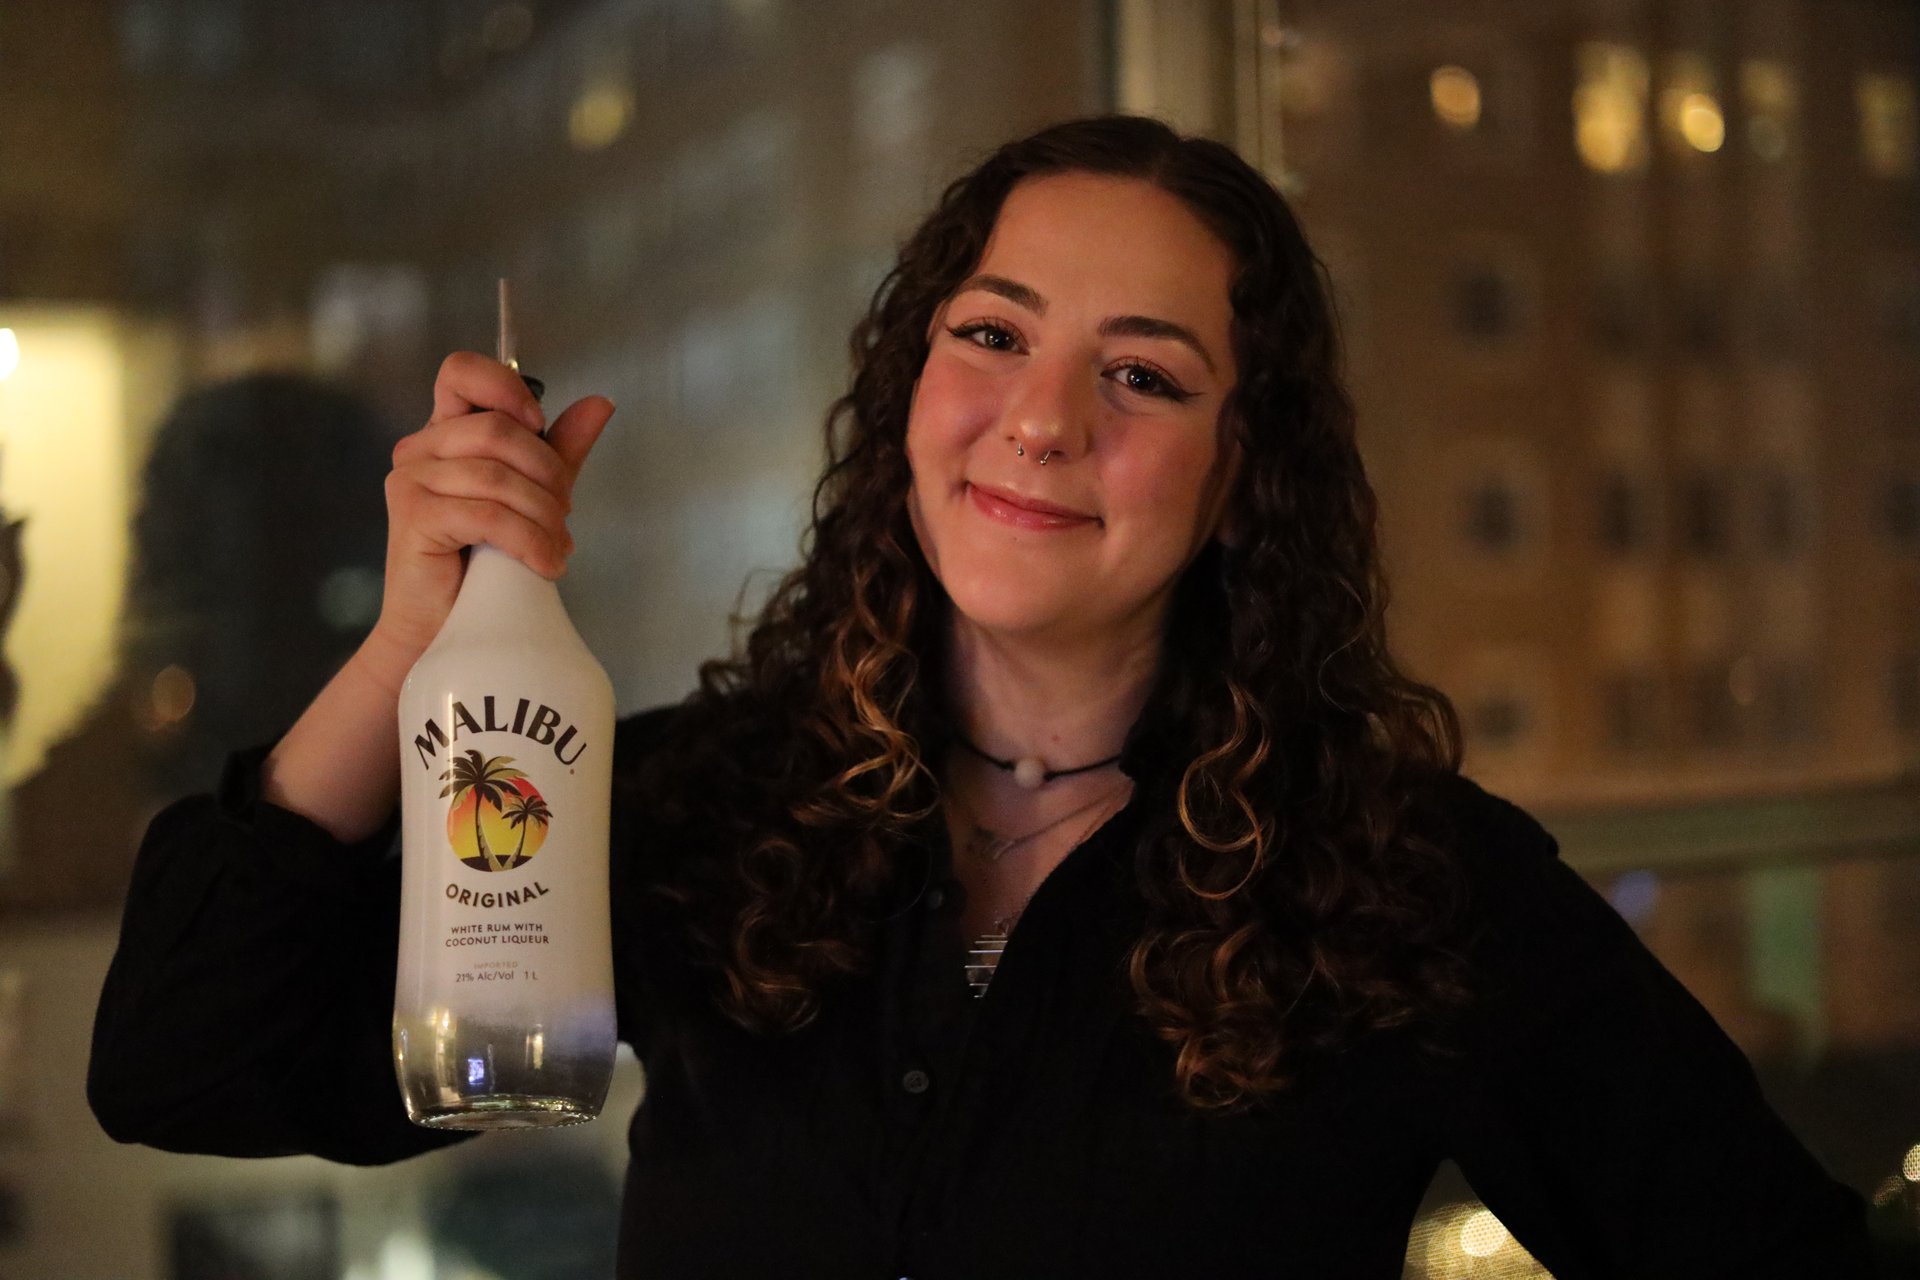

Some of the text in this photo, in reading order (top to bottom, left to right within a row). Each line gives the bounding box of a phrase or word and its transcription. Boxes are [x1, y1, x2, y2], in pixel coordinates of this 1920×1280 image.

[414, 696, 587, 771] MALIBU
[446, 882, 549, 908] ORIGINAL
[451, 923, 543, 934] WHITE RUM WITH
[445, 935, 550, 947] COCONUT LIQUEUR
[455, 973, 475, 982] 21%
[477, 970, 514, 981] Alc/Vol
